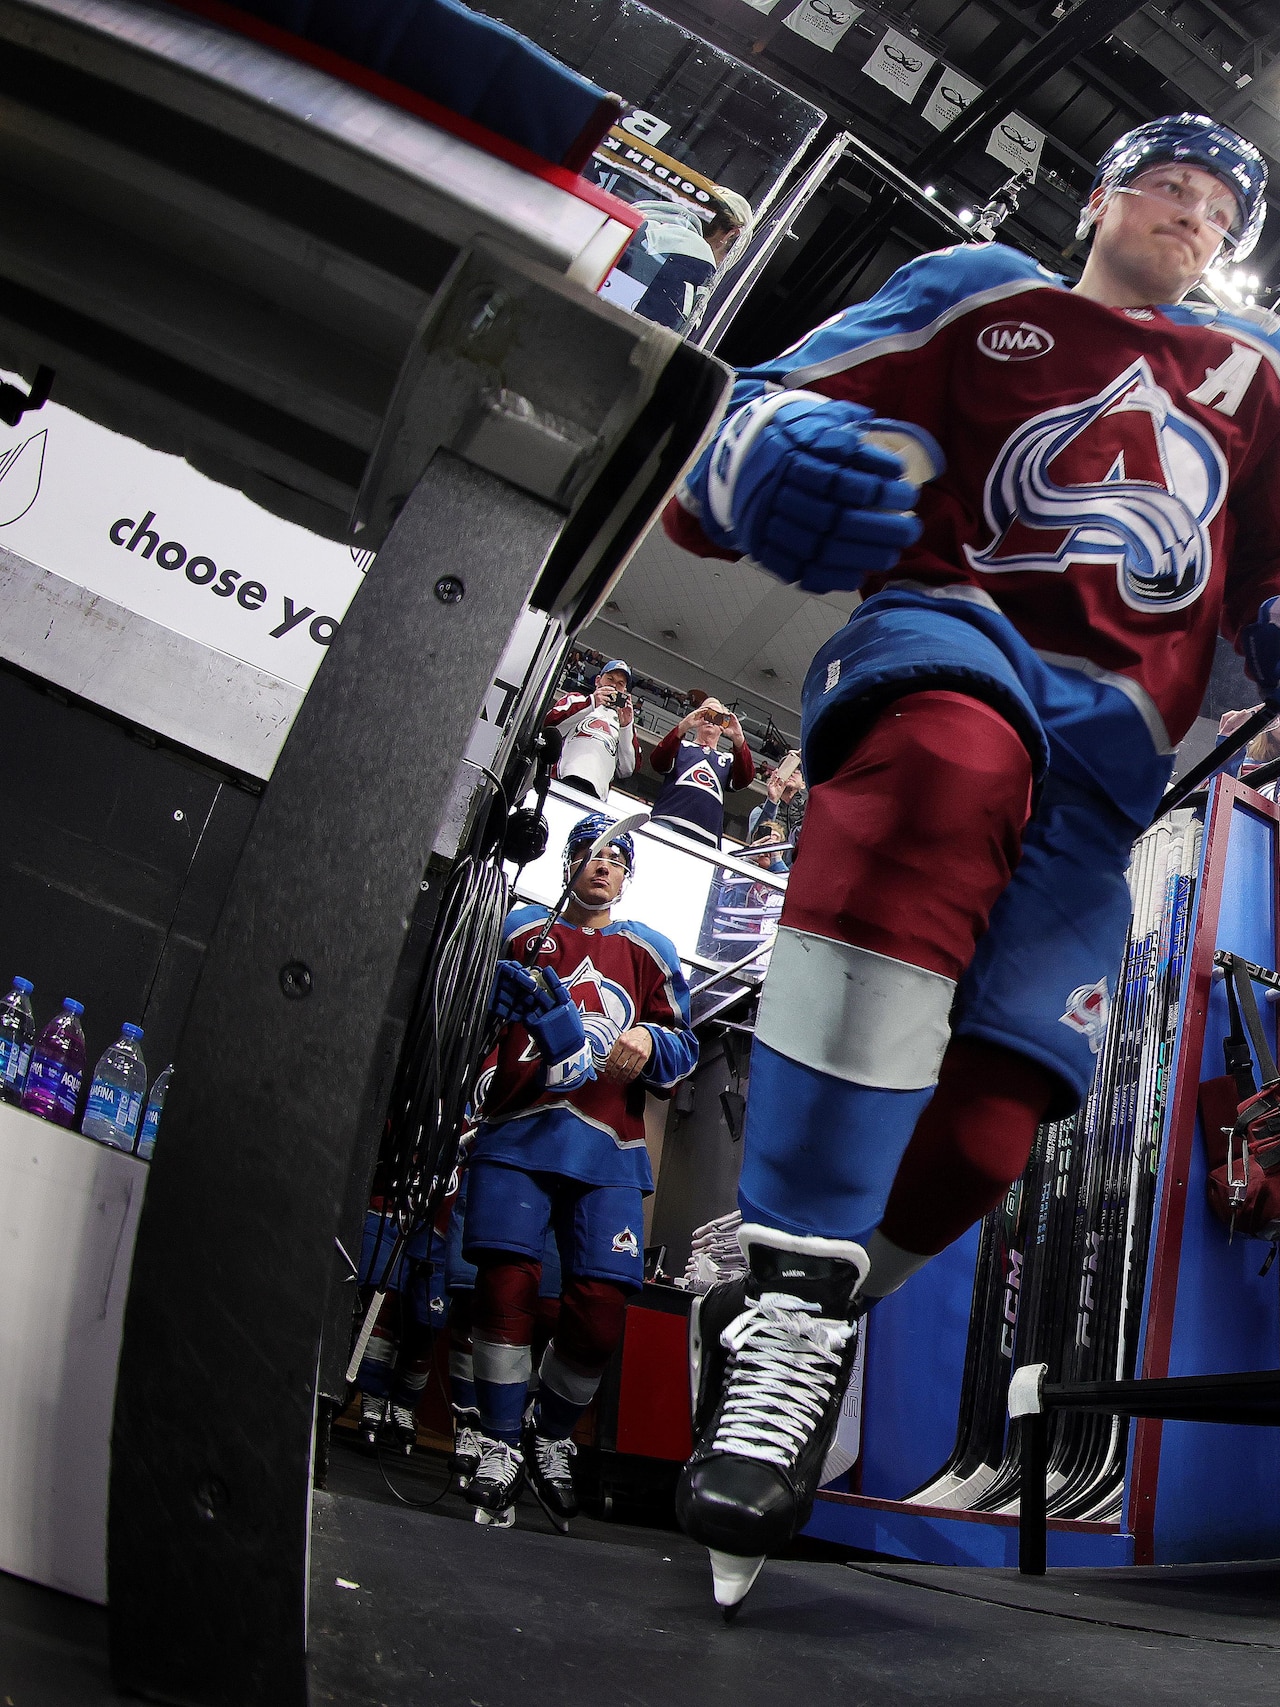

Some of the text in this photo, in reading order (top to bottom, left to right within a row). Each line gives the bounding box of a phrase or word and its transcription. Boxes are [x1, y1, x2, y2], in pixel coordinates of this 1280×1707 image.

[990, 329, 1043, 350] IMA
[1186, 341, 1264, 418] A
[109, 510, 341, 646] choose yo
[999, 1248, 1024, 1360] CCM
